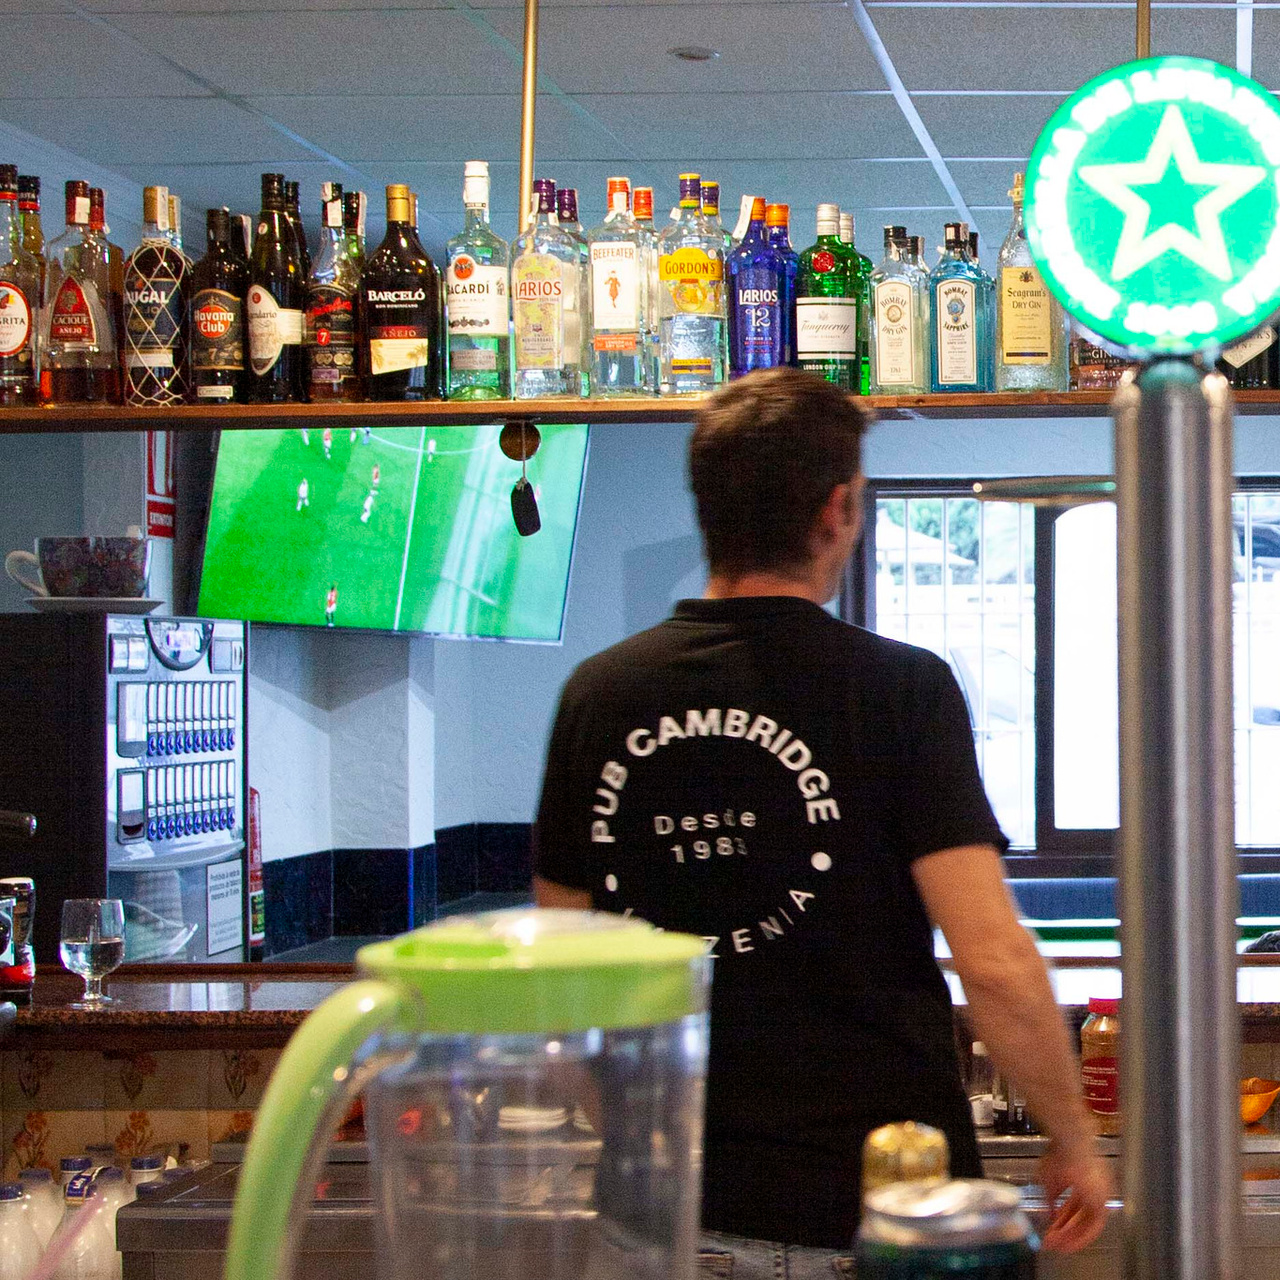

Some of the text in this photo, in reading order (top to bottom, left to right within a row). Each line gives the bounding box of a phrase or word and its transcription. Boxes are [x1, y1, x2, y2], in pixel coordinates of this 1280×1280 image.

[593, 247, 634, 260] BEEFEATER
[665, 261, 716, 275] GORDON'S
[126, 291, 170, 304] UGAL
[368, 288, 426, 303] BARCELÓ
[515, 281, 562, 301] LARIOS
[739, 289, 778, 306] LARIOS
[943, 287, 968, 297] BOMBAY
[1007, 287, 1047, 299] Seagram's
[880, 296, 908, 308] BOMBAY
[53, 317, 89, 325] CACIQUE
[194, 310, 235, 322] Havana
[745, 307, 771, 327] 12
[200, 322, 226, 332] Club
[381, 329, 417, 338] AÑEJO
[801, 320, 851, 334] Tanqueray
[881, 325, 908, 336] DRY GIN
[320, 332, 327, 343] 7
[591, 708, 842, 843] PUB CAMBRIDGE
[653, 808, 757, 835] Desde
